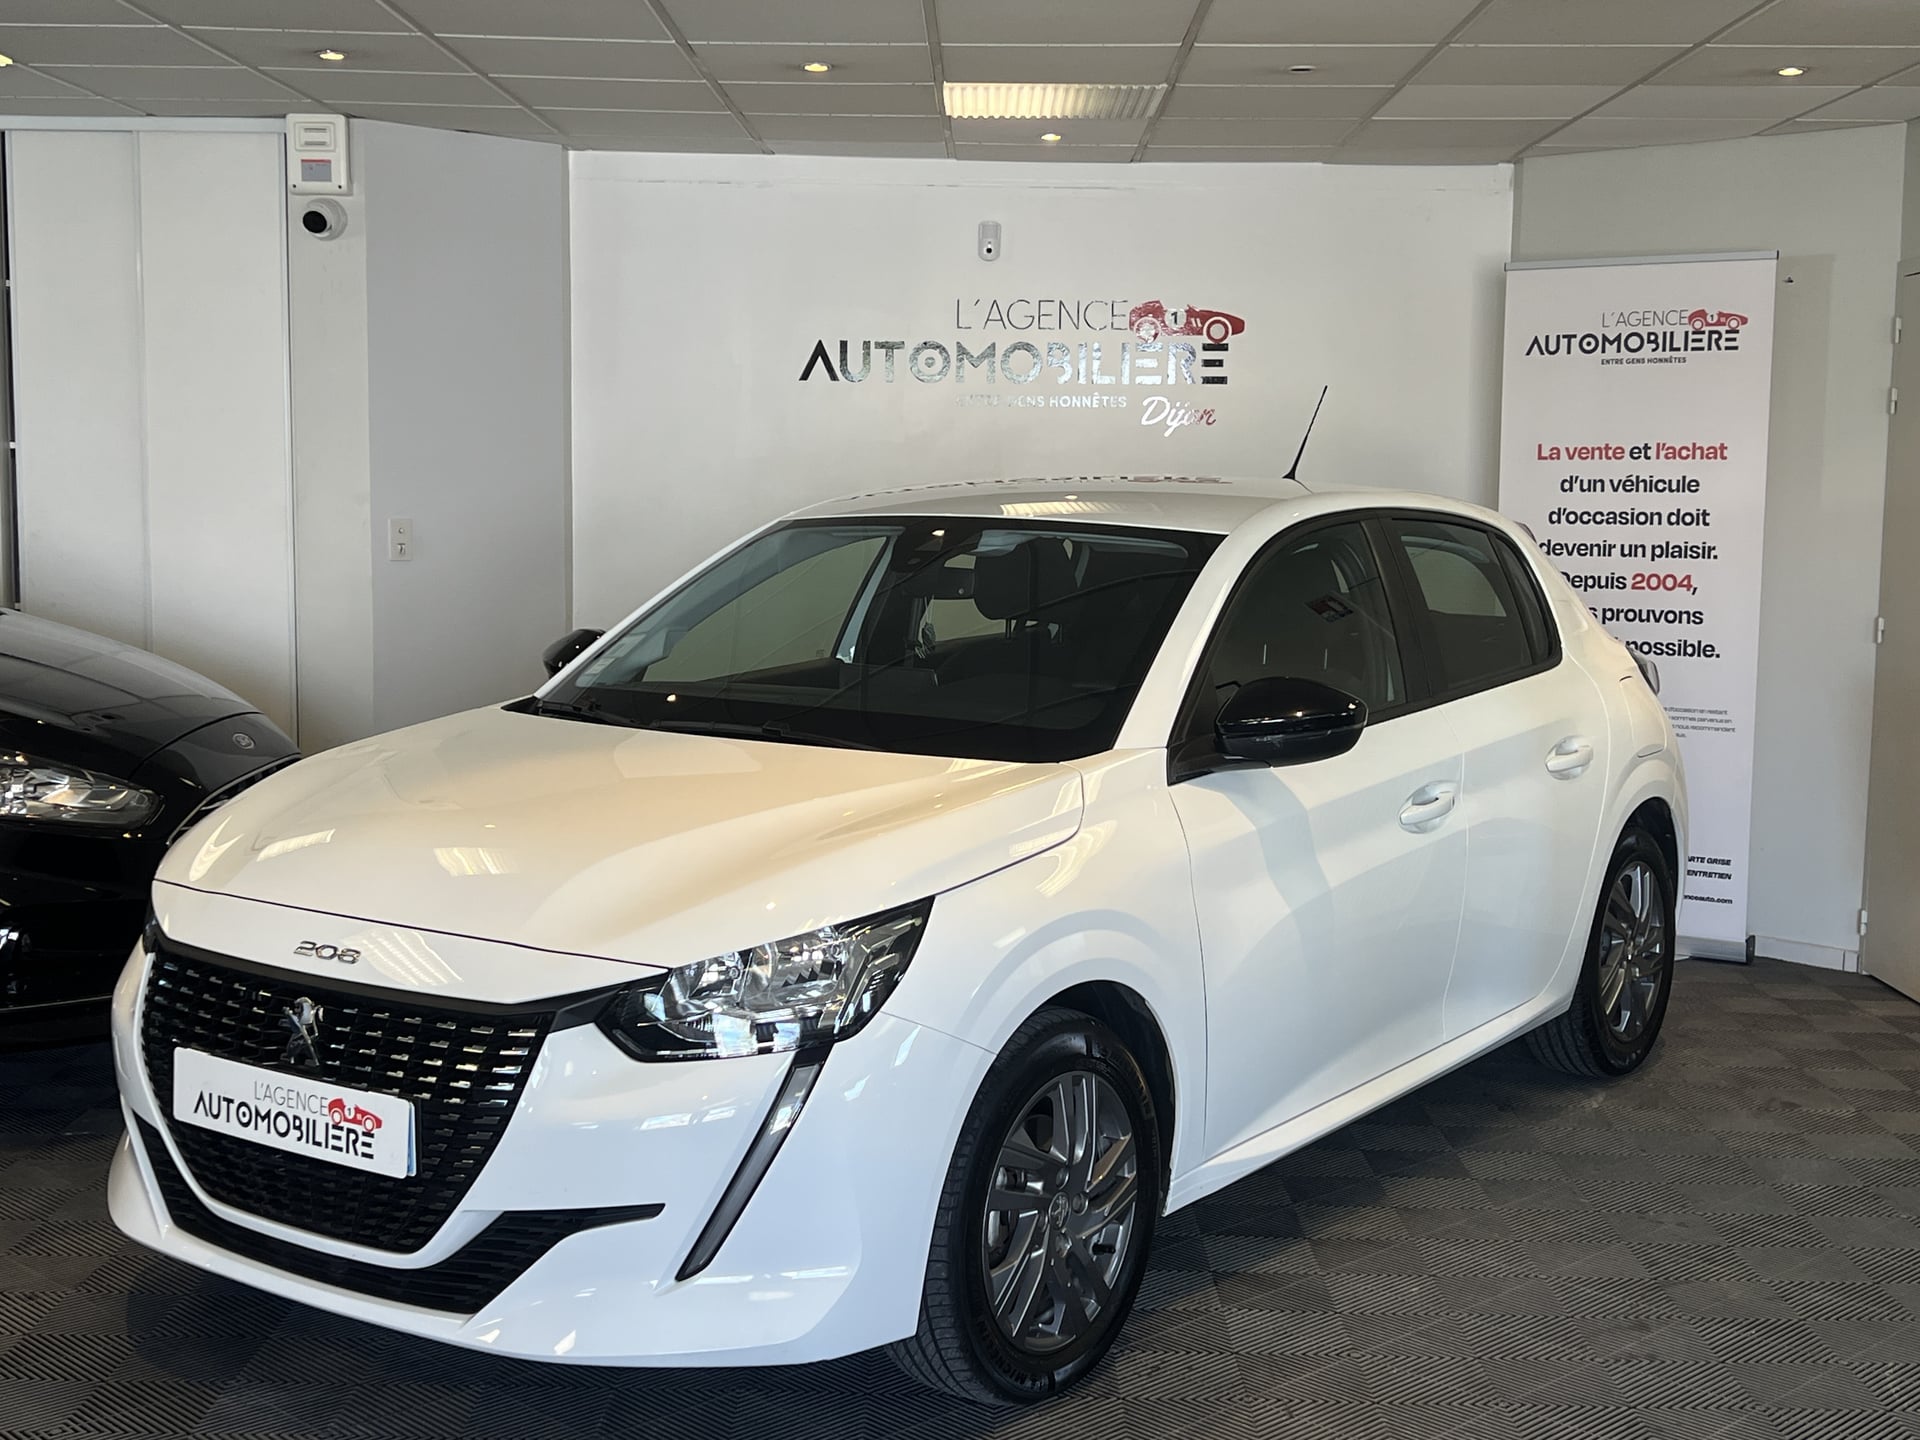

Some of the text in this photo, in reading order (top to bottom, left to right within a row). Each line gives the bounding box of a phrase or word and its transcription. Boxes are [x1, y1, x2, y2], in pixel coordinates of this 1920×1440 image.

[956, 298, 1128, 331] L'AGENCE
[1602, 309, 1689, 328] L'AGENCE
[1601, 355, 1687, 365] ENTRE GENS HONNÊTES
[1049, 392, 1128, 408] HONNÊTES
[1140, 396, 1217, 437] Dijon
[1537, 442, 1728, 460] La vente et l'achat
[1560, 474, 1700, 493] d'un véhicule
[1548, 507, 1710, 526] d'occasion doit
[1538, 539, 1718, 561] devenir un plaisir.
[1631, 573, 1698, 595] 2004,
[1602, 607, 1704, 625] prouvons
[293, 940, 362, 965] 208
[254, 1081, 328, 1117] L'AGENCE
